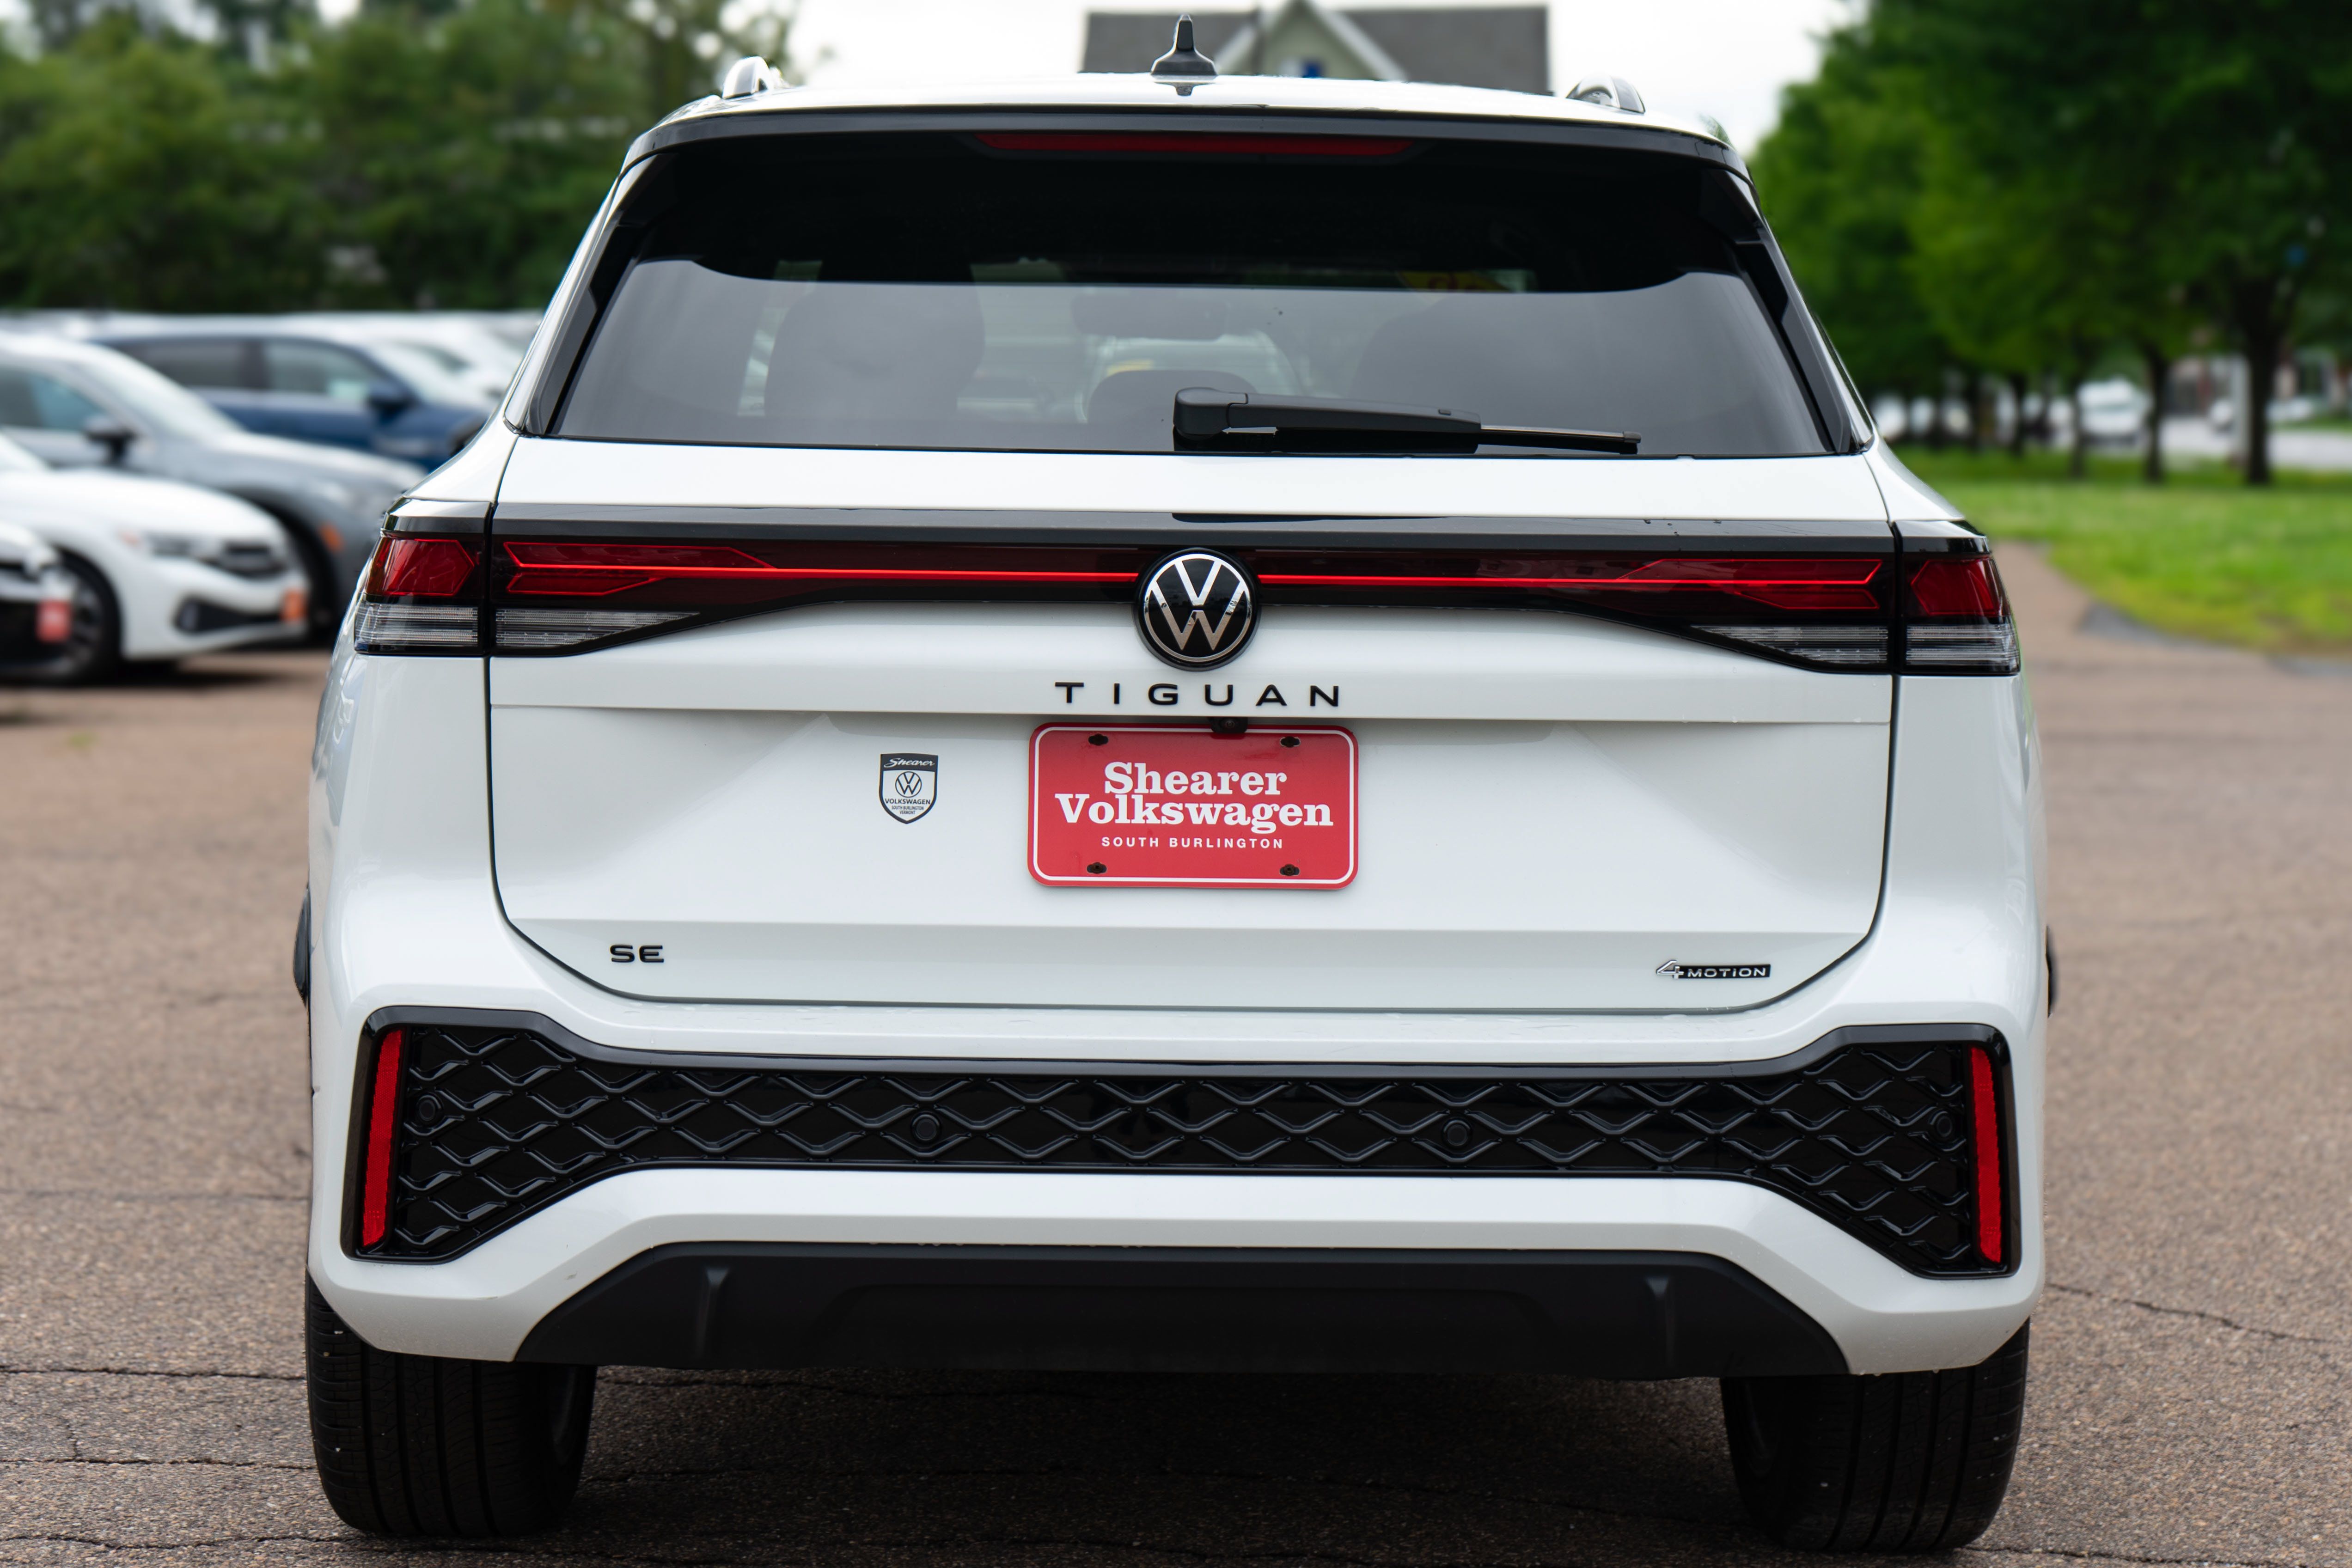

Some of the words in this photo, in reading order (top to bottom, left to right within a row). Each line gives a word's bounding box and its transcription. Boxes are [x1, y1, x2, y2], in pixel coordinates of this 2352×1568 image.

[1055, 682, 1339, 707] TIGUAN
[884, 758, 935, 768] Shearer
[1104, 761, 1287, 795] Shearer
[1055, 793, 1333, 834] Volkswagen
[1101, 836, 1159, 847] SOUTH
[1169, 837, 1283, 848] BURLINGTON
[610, 944, 664, 963] SE
[1656, 959, 1766, 979] 4MOTION
